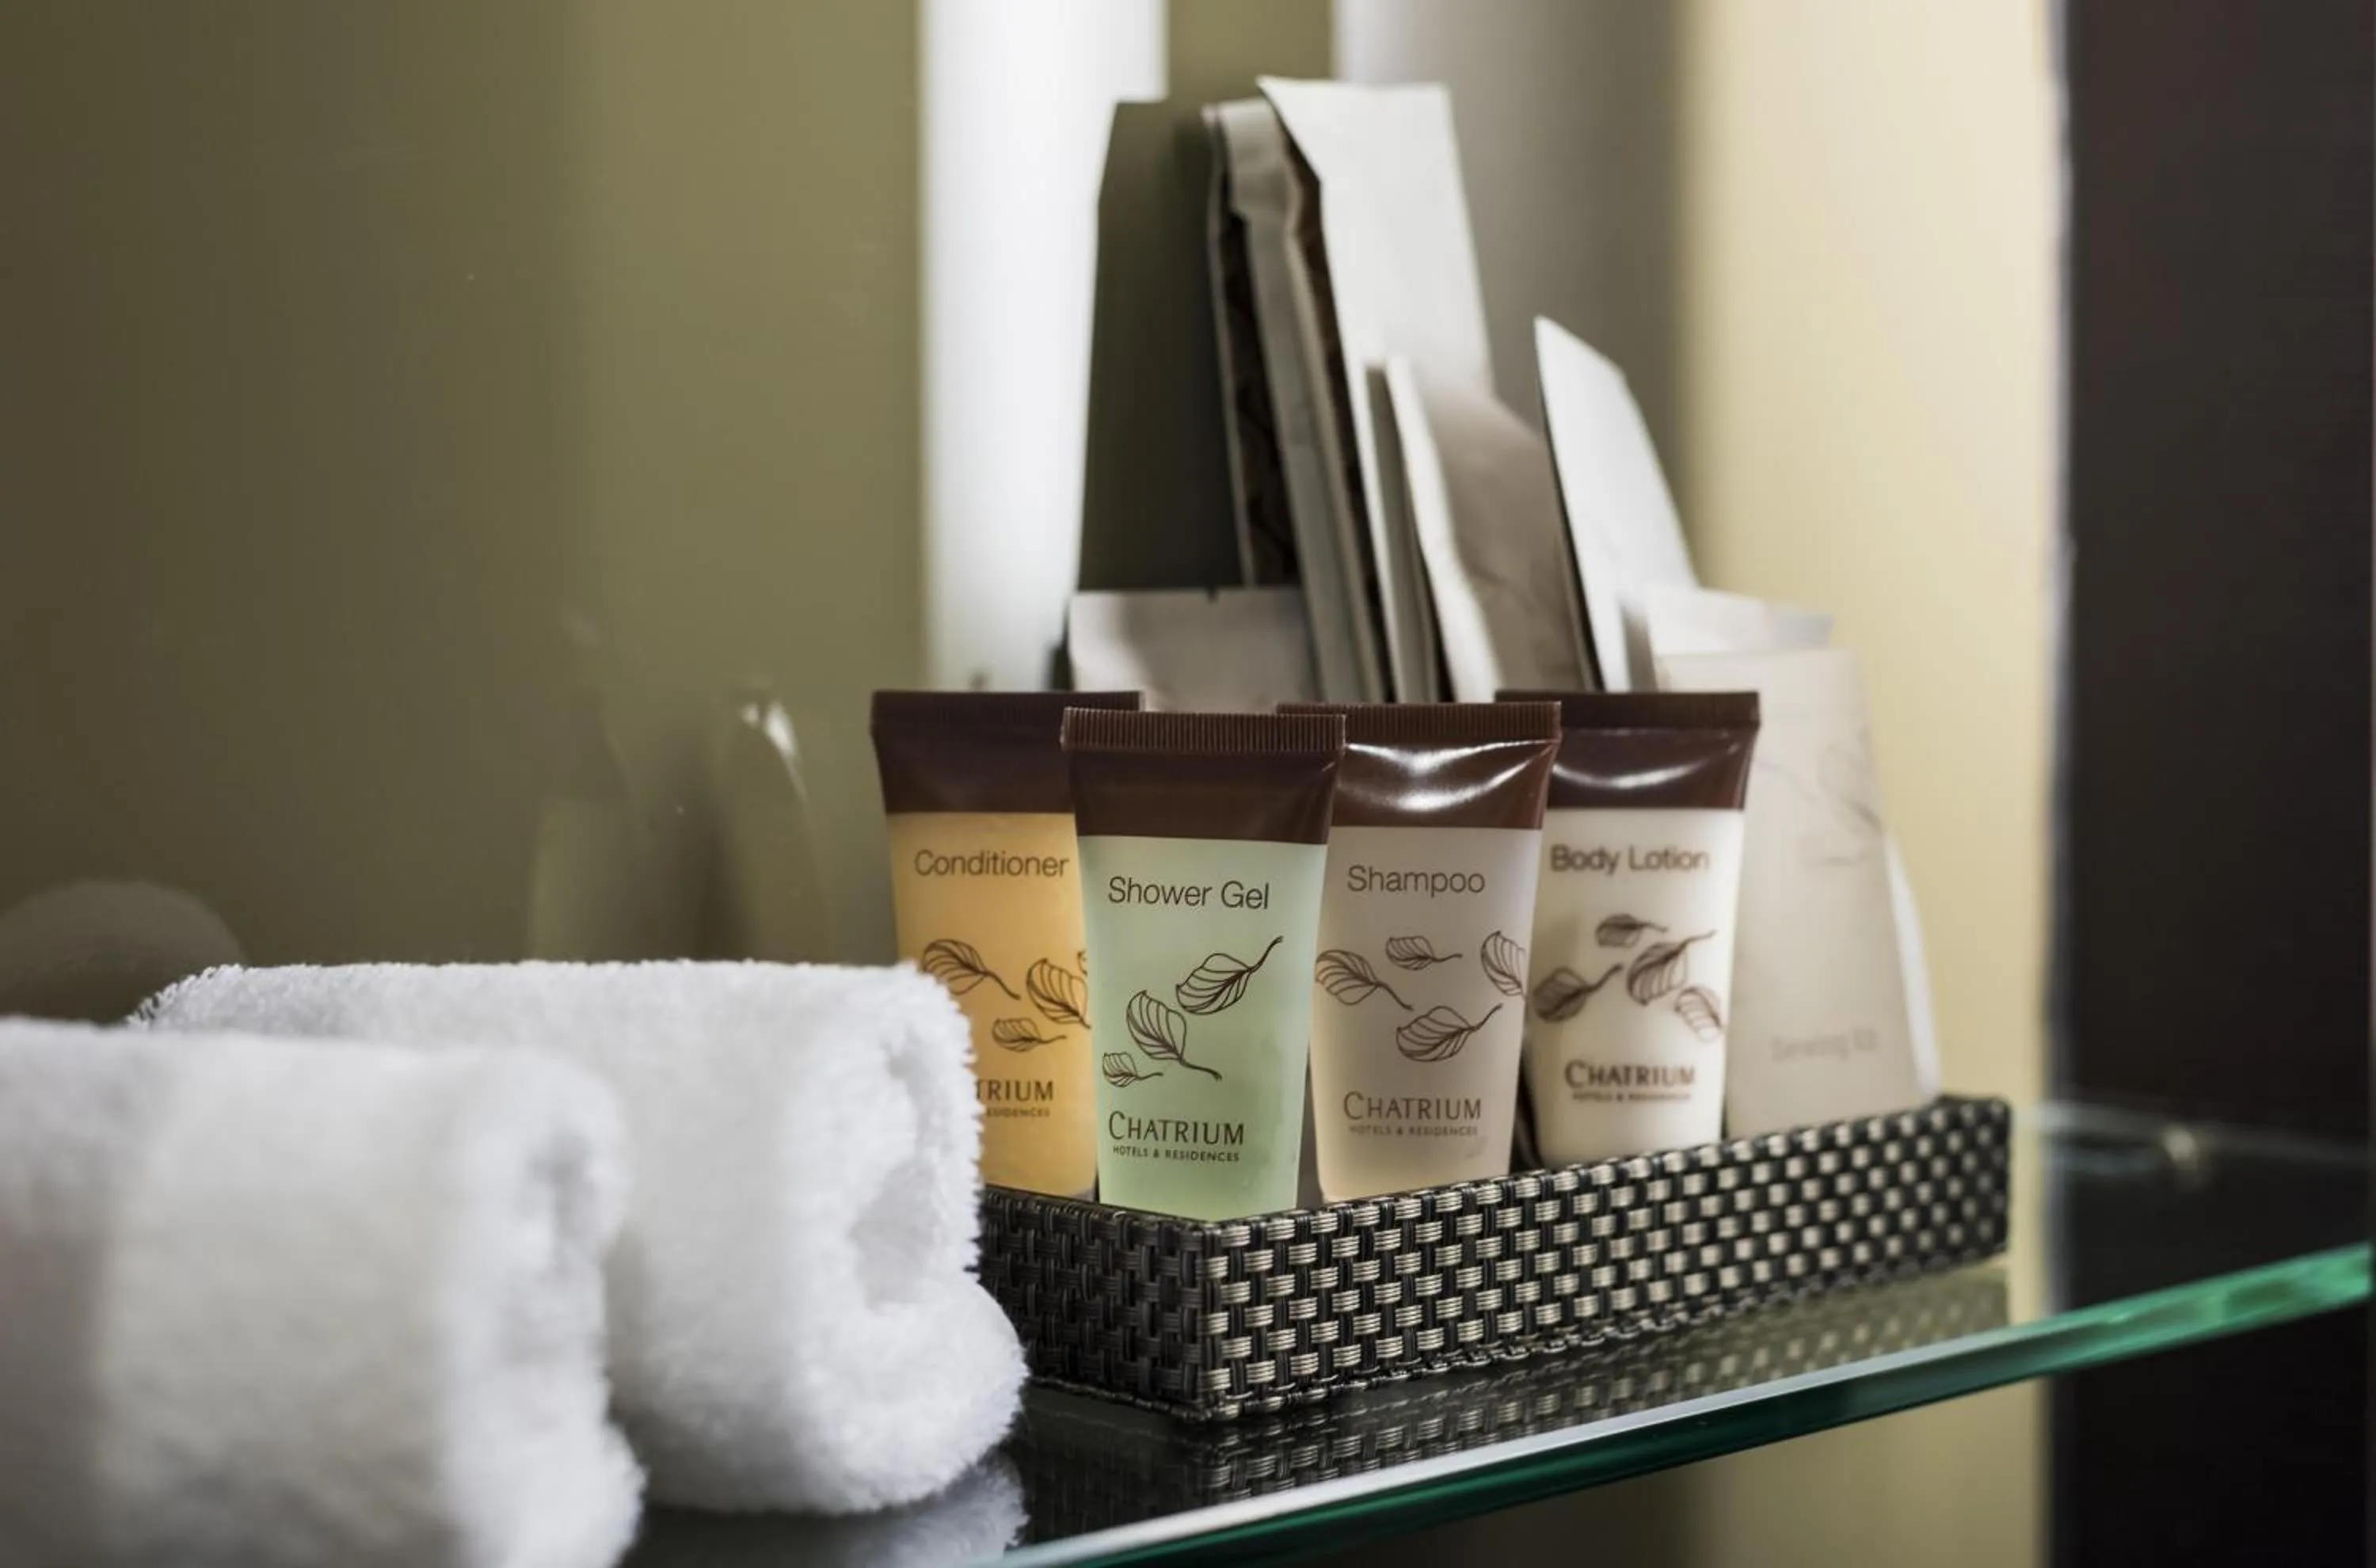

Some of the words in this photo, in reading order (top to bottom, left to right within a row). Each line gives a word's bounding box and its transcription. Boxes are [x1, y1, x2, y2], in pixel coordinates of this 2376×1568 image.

[913, 848, 1069, 877] Conditioner
[1550, 843, 1620, 877] Body
[1628, 843, 1711, 873] Lotion
[1108, 875, 1213, 907] Shower
[1220, 880, 1270, 910] Gel
[1347, 864, 1486, 899] Shampoo
[1564, 1058, 1695, 1090] CHATRIUM
[975, 1079, 1054, 1102] TRIUM
[1343, 1090, 1482, 1121] CHATRIUM
[1109, 1110, 1245, 1146] CHATRIUM
[1349, 1125, 1392, 1135] HOTELS
[1113, 1145, 1148, 1159] HOTELS
[1152, 1148, 1160, 1159] &
[1165, 1149, 1240, 1163] RESIDENCES
